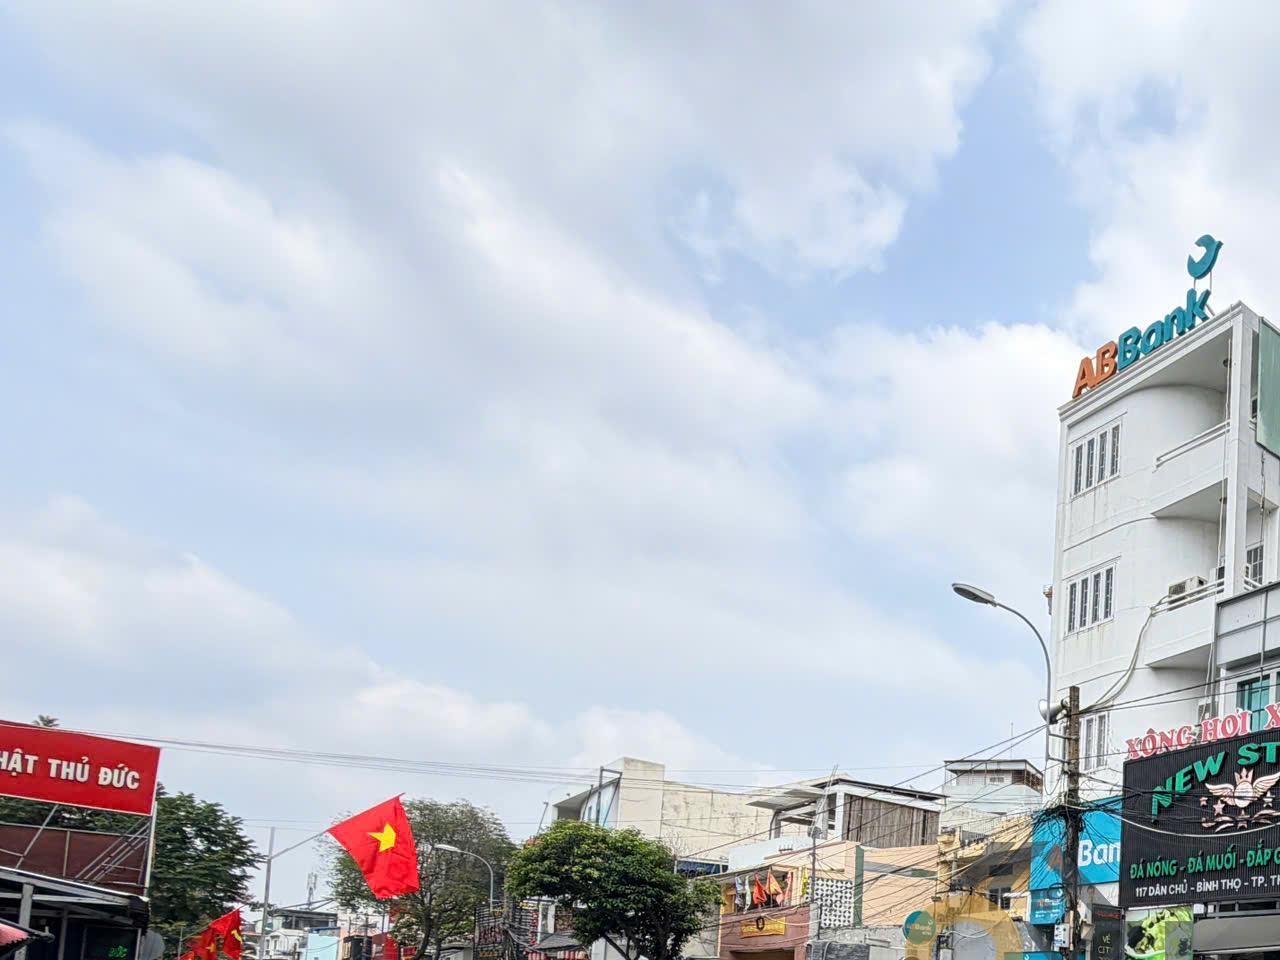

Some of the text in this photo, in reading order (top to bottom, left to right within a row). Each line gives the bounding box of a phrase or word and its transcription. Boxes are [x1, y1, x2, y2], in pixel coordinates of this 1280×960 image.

[1125, 726, 1197, 761] XÔNG
[1200, 708, 1252, 744] HƠI
[48, 756, 90, 783] THỦ
[98, 763, 141, 790] ĐỨC
[1152, 751, 1226, 822] NEW
[1130, 858, 1145, 879] ĐÁ
[1146, 855, 1178, 879] NÓNG
[1187, 850, 1203, 874] ĐÁ
[1205, 844, 1237, 872] MUỐI
[1135, 887, 1148, 898] 117
[1148, 883, 1168, 897] DÂN
[1168, 879, 1188, 895] CHỦ
[1196, 878, 1219, 893] BÌNH
[1220, 878, 1242, 892] THỌ
[1251, 876, 1268, 888] TP.
